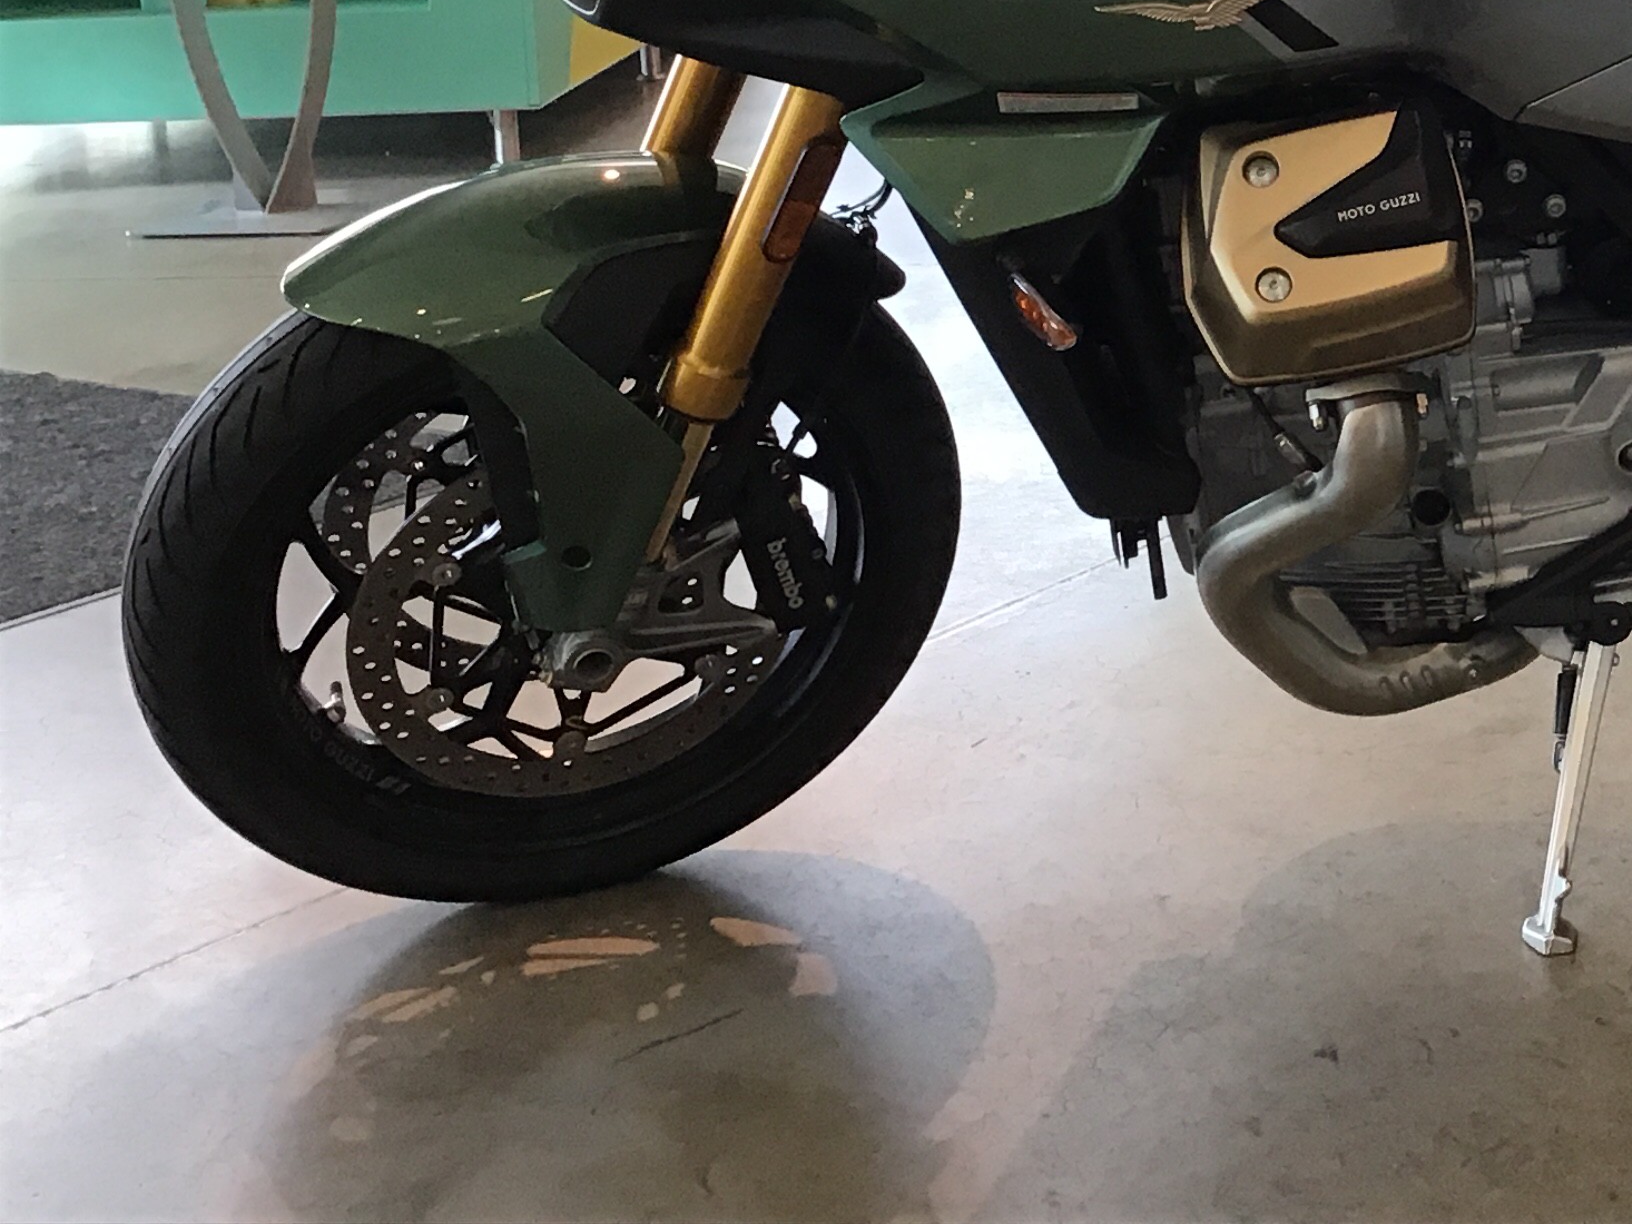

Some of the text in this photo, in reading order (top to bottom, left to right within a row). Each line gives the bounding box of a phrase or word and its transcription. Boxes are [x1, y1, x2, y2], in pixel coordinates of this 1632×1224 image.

[1337, 191, 1421, 222] MOTO GUZZI
[766, 537, 804, 610] brembo
